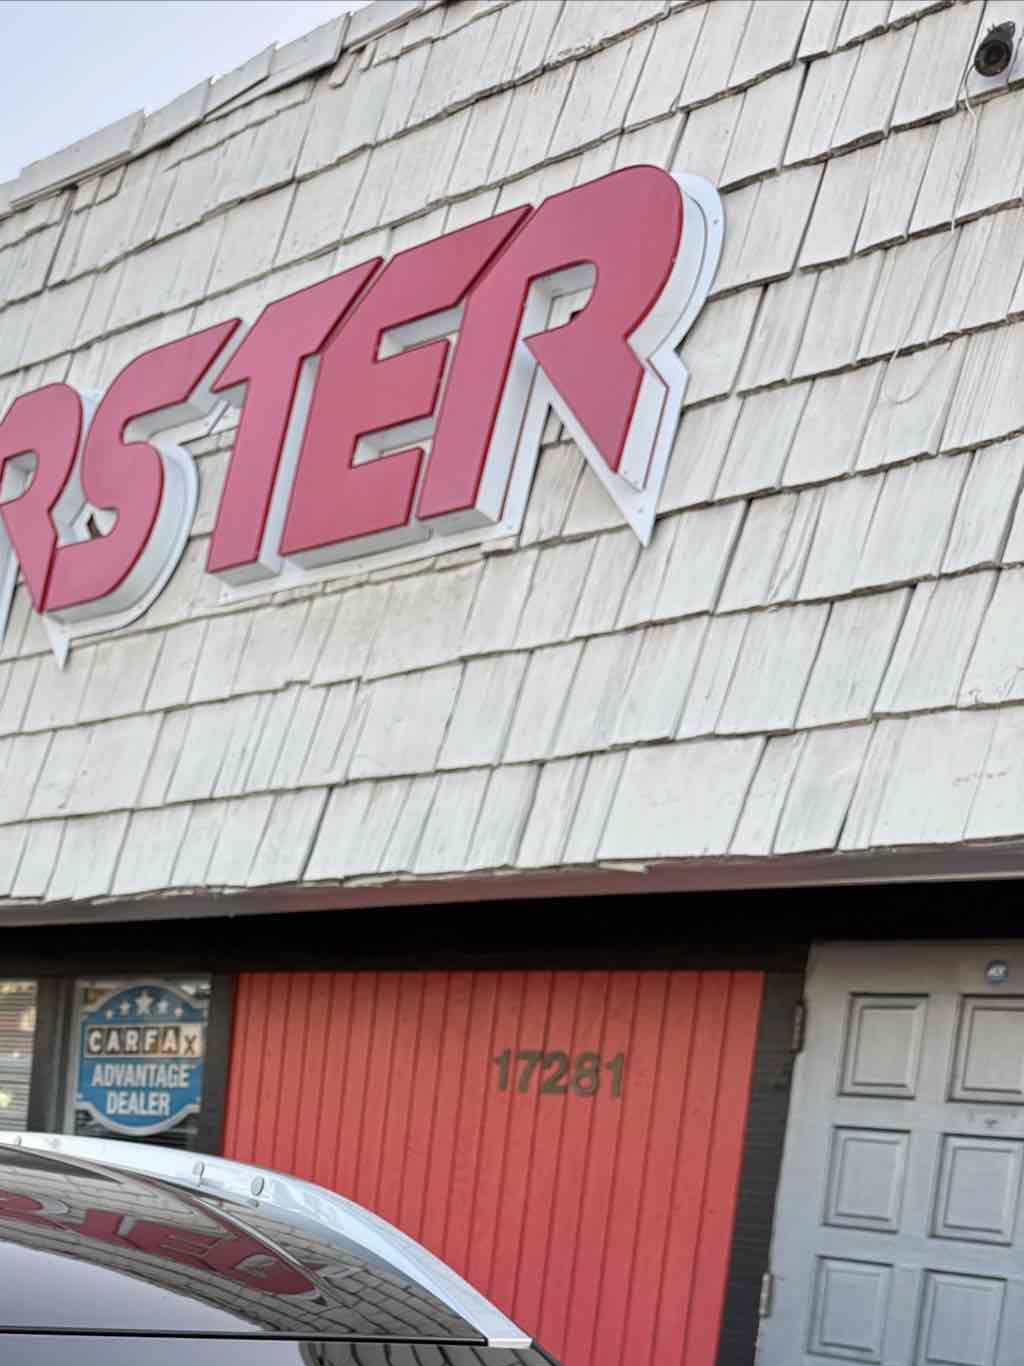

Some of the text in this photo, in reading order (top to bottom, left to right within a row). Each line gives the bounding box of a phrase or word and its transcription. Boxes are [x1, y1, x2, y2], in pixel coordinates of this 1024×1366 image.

[89, 1029, 197, 1056] CARFAX
[92, 1064, 191, 1088] ADVANTAGE
[491, 1048, 625, 1098] 17281
[107, 1091, 171, 1116] DEALER
